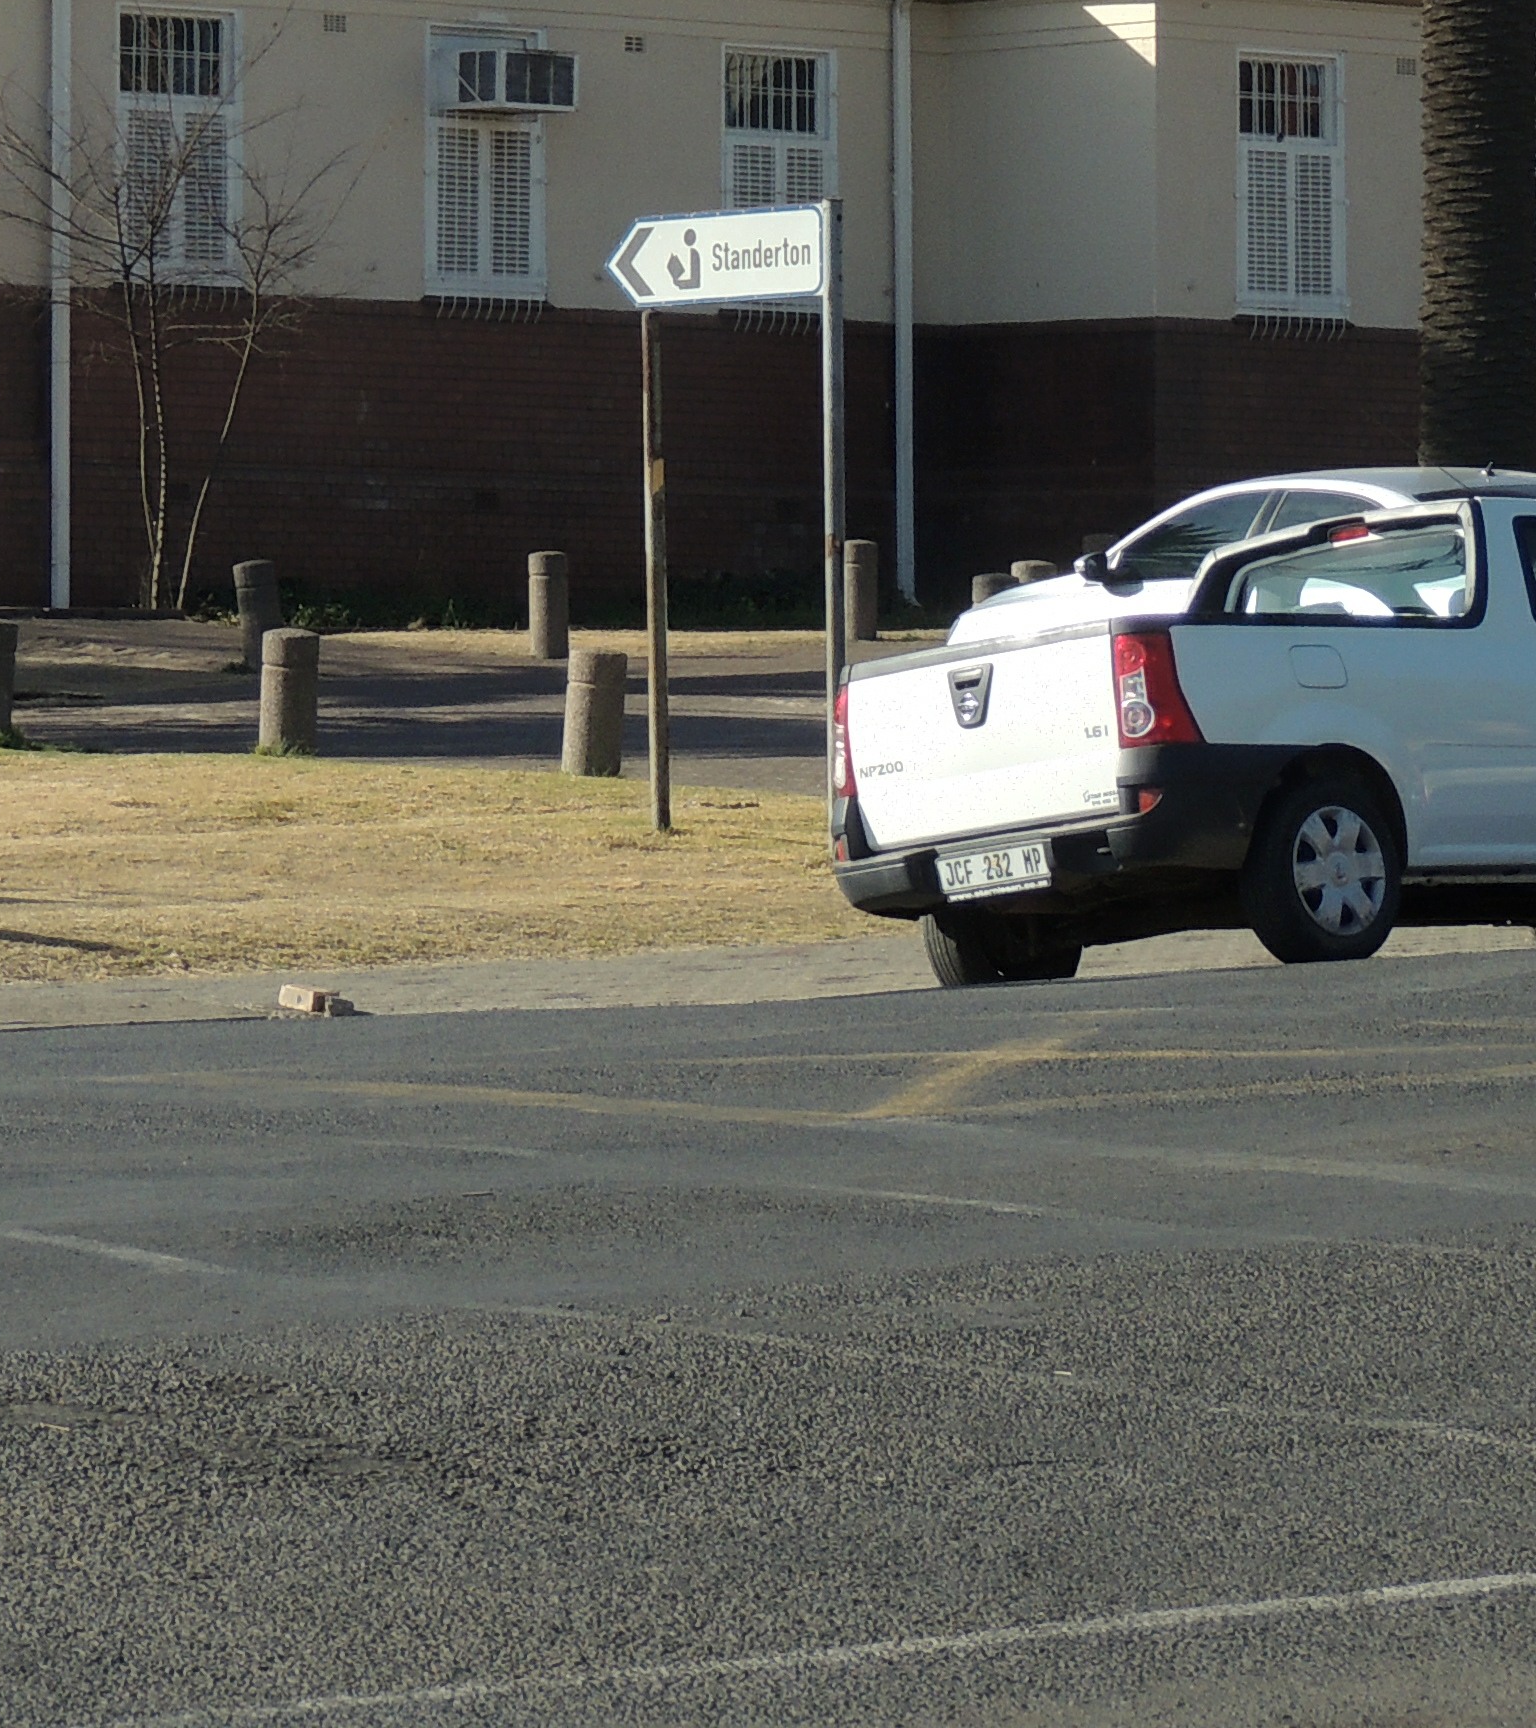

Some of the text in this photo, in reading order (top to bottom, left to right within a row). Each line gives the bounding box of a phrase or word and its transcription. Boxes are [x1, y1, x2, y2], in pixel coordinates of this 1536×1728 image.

[711, 237, 811, 271] Standerton
[859, 760, 904, 779] NP200
[946, 859, 973, 887] JCF
[983, 852, 1014, 881] 232
